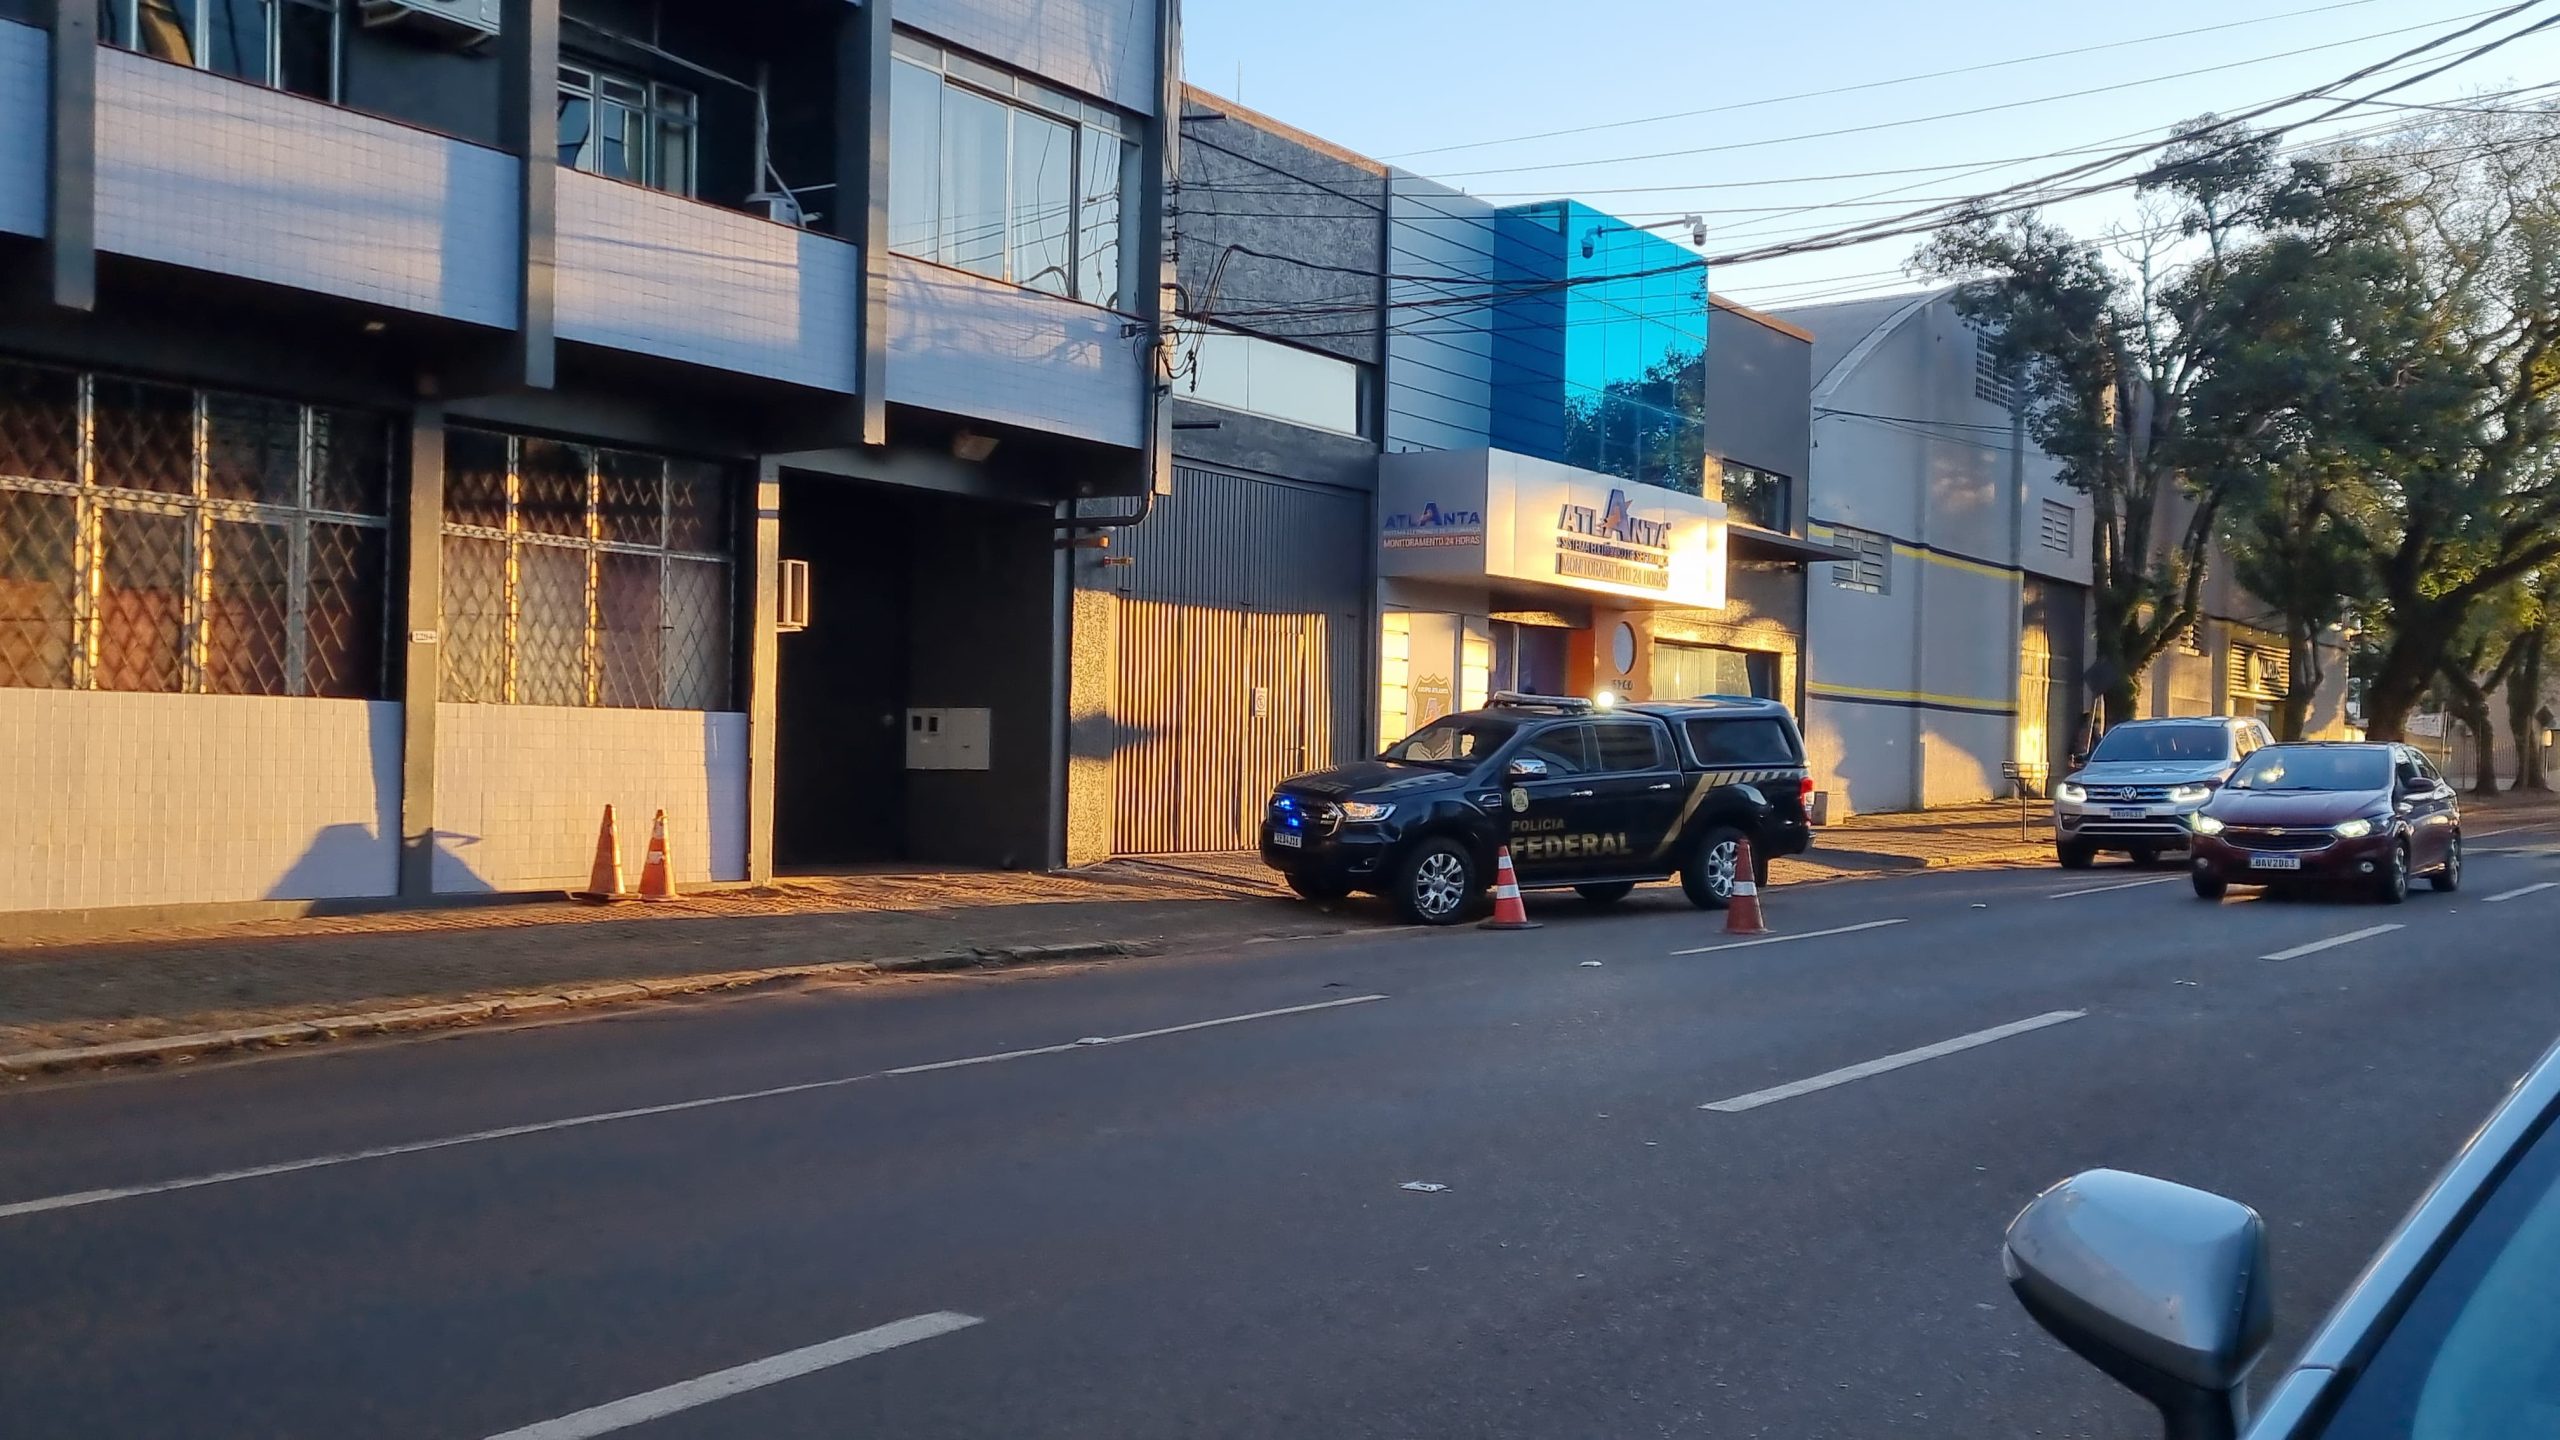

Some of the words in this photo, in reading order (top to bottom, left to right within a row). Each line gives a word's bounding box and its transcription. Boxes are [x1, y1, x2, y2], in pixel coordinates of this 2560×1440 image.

[1384, 502, 1481, 528] ATLANTA
[1557, 488, 1670, 550] ATLANTA
[1384, 537, 1444, 548] MONITORAMENTO
[1445, 537, 1455, 546] 24
[1455, 535, 1480, 545] HORAS
[1562, 556, 1632, 580] MONITORAMENTO
[1632, 567, 1642, 584] 24
[1643, 569, 1669, 588] HORAS
[1510, 832, 1632, 860] FEDERAL
